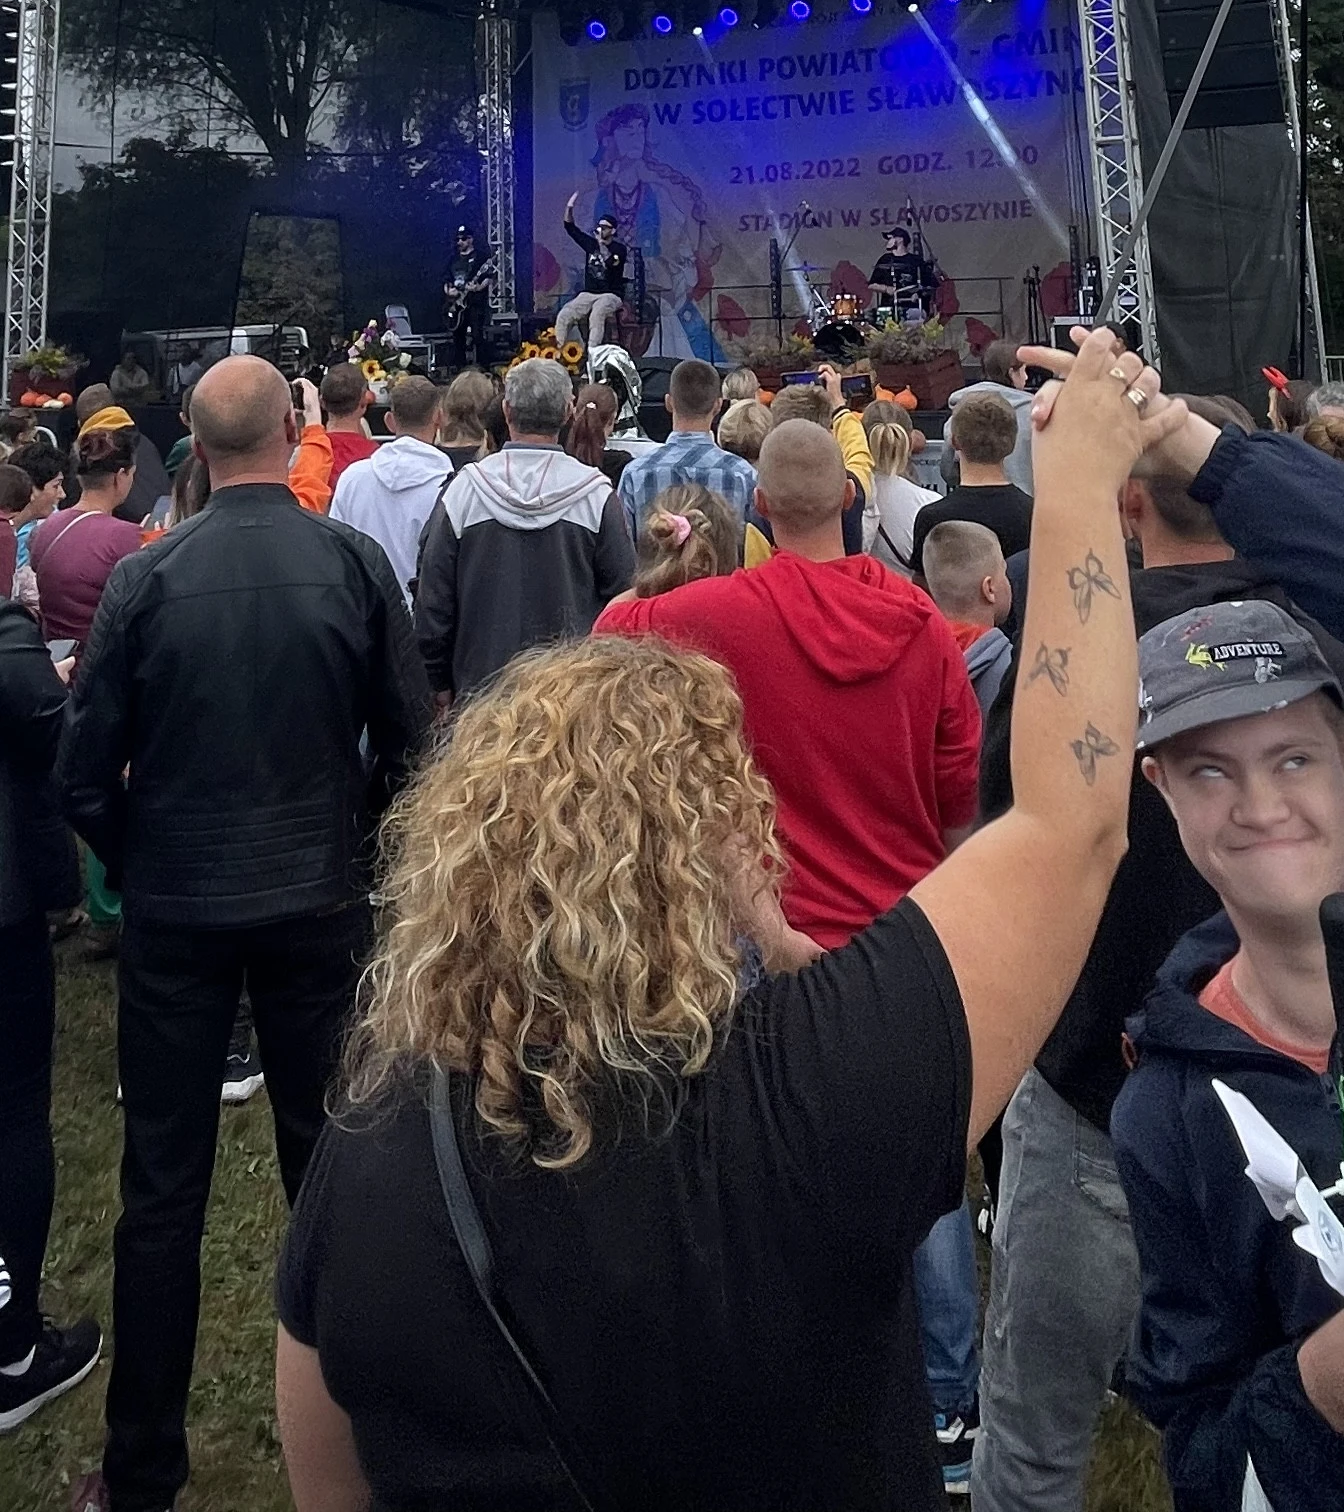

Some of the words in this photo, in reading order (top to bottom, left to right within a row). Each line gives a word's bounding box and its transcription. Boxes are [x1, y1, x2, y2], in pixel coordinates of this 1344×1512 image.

[624, 57, 747, 92] DOŻYNKI
[654, 102, 682, 126] W
[692, 90, 855, 125] SOŁECTWIE
[729, 157, 861, 185] 21.08.2022
[877, 151, 953, 175] GODZ.
[965, 145, 1039, 169] 12.0
[738, 210, 833, 232] STADION
[841, 209, 861, 227] W
[869, 199, 1035, 226] SŁAWOSZYNIE
[1213, 643, 1283, 660] ADVENTURE
